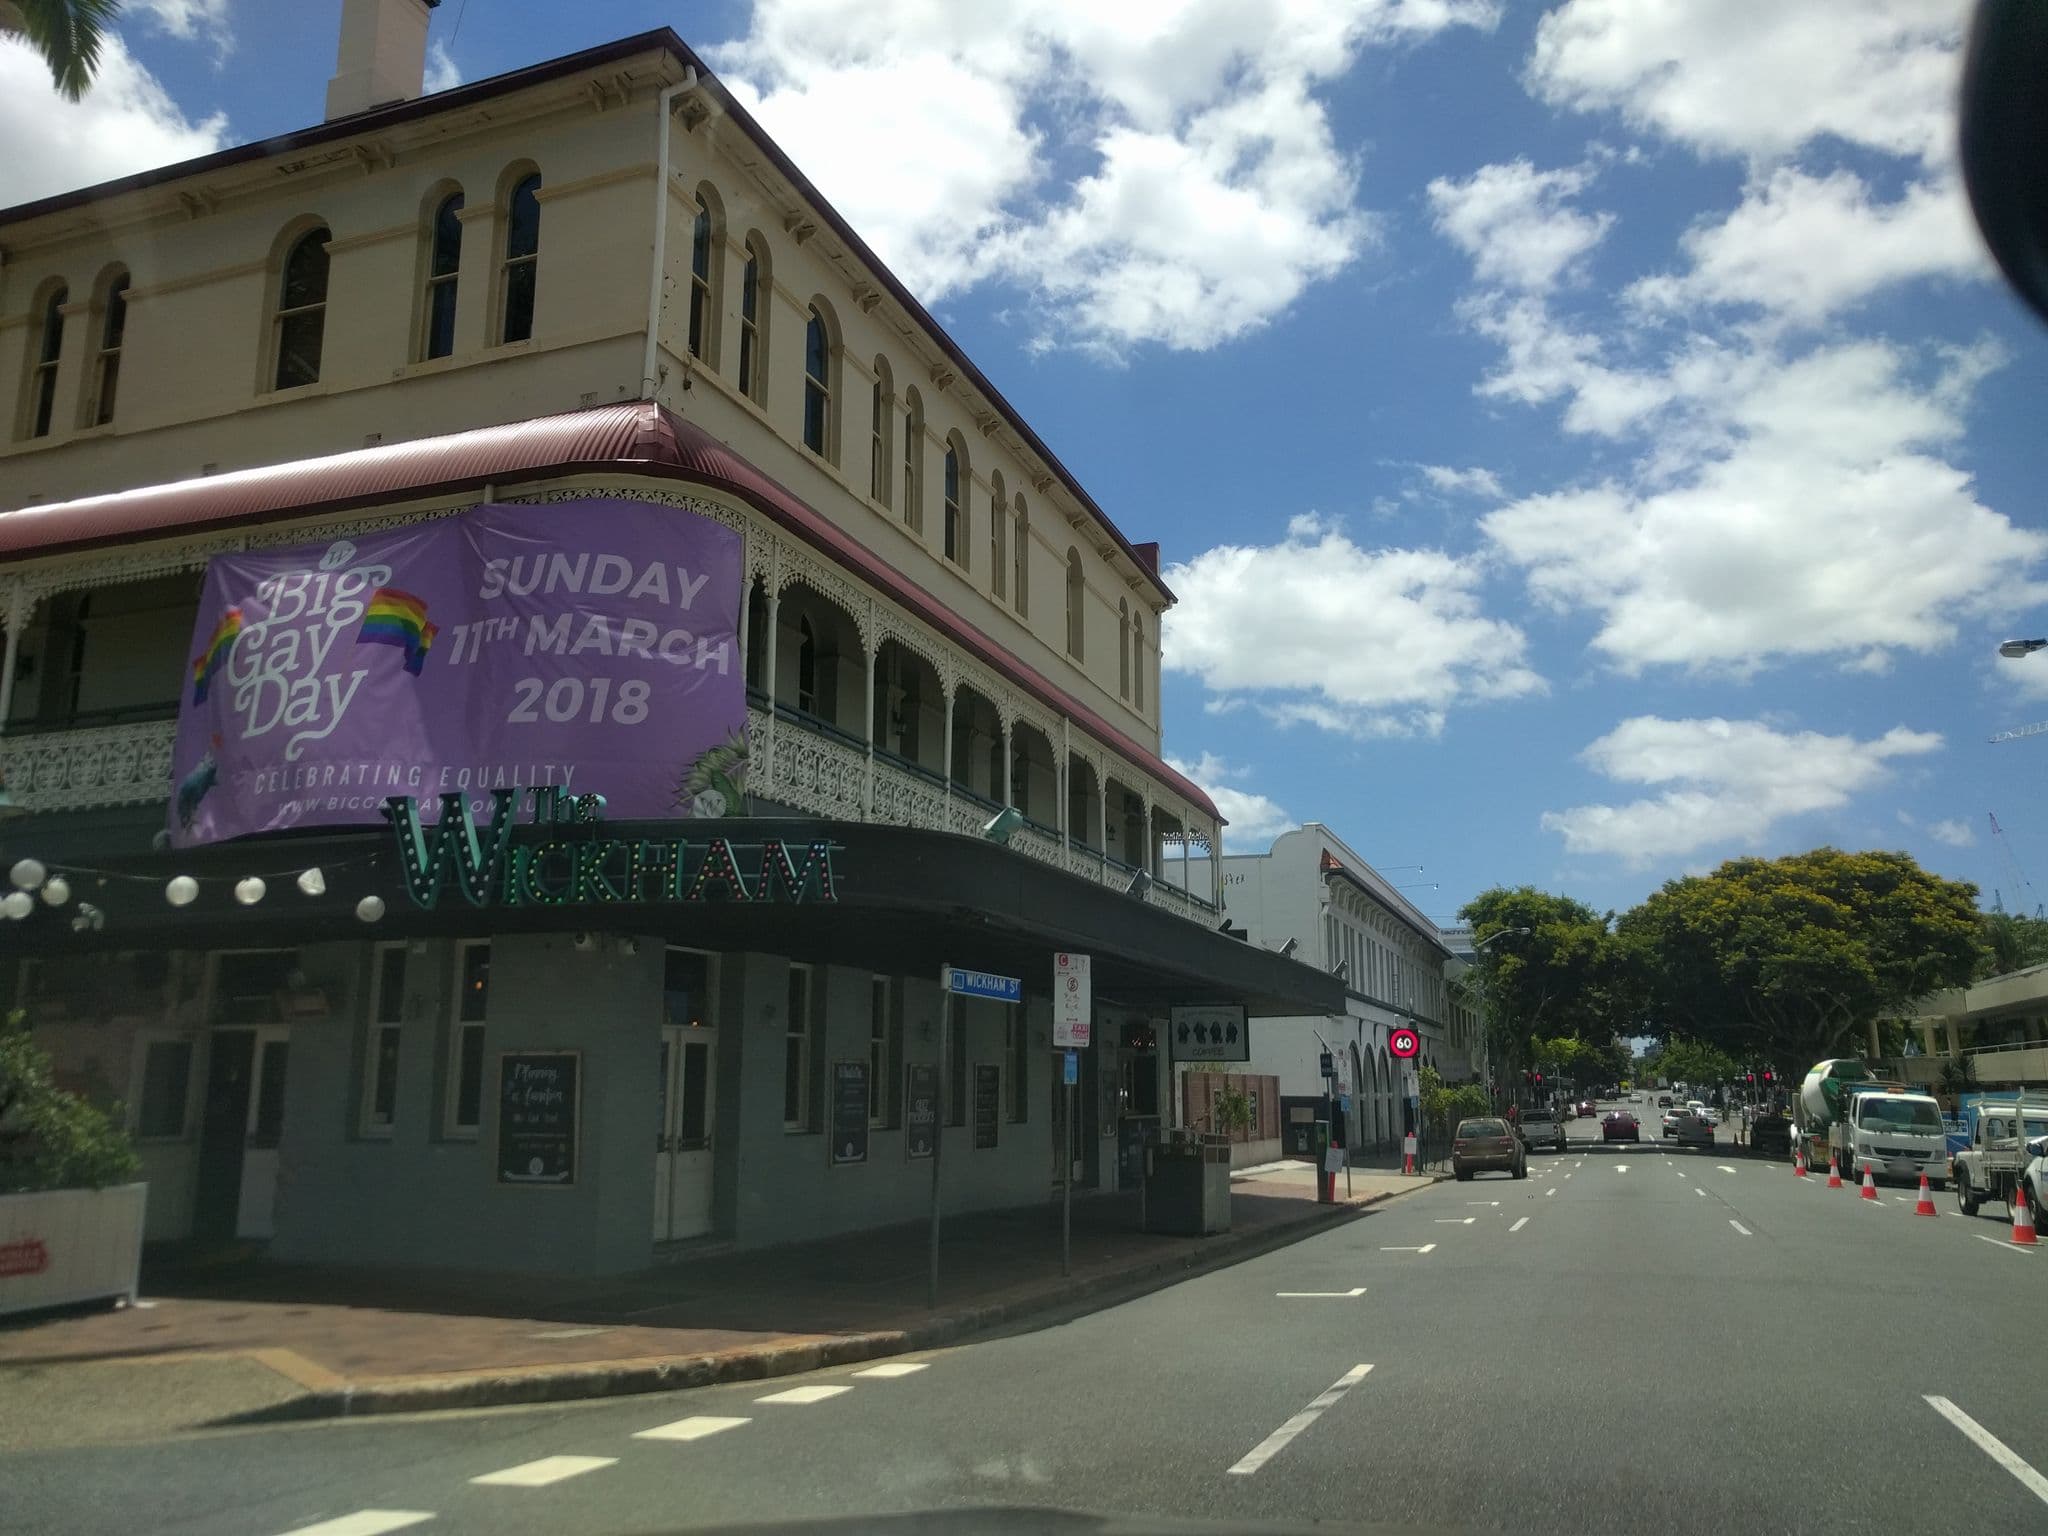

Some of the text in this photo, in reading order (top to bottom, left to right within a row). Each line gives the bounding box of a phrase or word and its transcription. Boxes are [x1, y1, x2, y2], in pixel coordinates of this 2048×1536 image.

[256, 563, 393, 628] Big
[479, 552, 710, 611] SUNDAY
[227, 621, 342, 688] Gay
[448, 612, 730, 676] 11TH MARCH
[234, 669, 369, 762] Day
[507, 677, 651, 725] 2018
[254, 763, 576, 795] CELEBRATING EQUALITY
[527, 785, 608, 825] The
[384, 784, 840, 912] WICKHAM
[966, 972, 1019, 994] WICKHAM ST
[1396, 1037, 1413, 1050] 60
